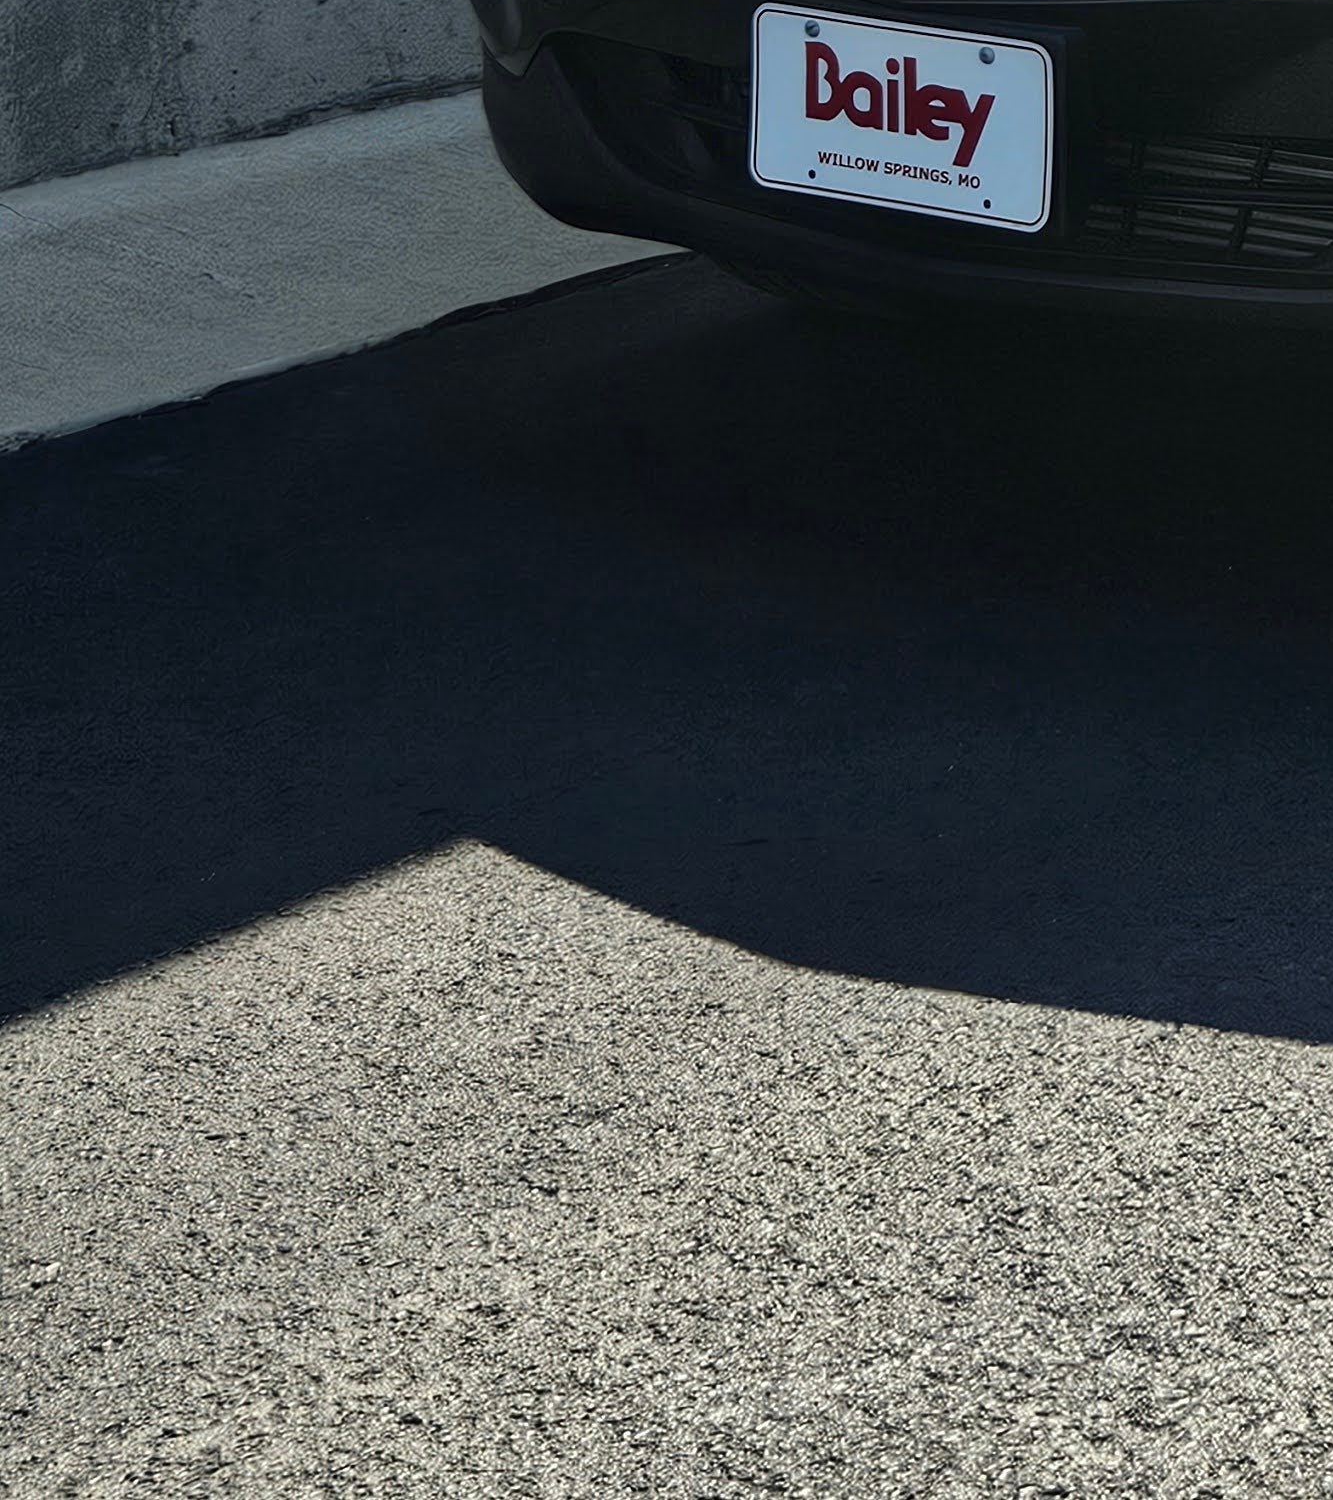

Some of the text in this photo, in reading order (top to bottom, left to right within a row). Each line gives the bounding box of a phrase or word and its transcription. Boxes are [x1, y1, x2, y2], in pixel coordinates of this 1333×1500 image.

[805, 41, 996, 168] Bailey
[818, 151, 981, 189] WILLOW SPRINGS, MO
